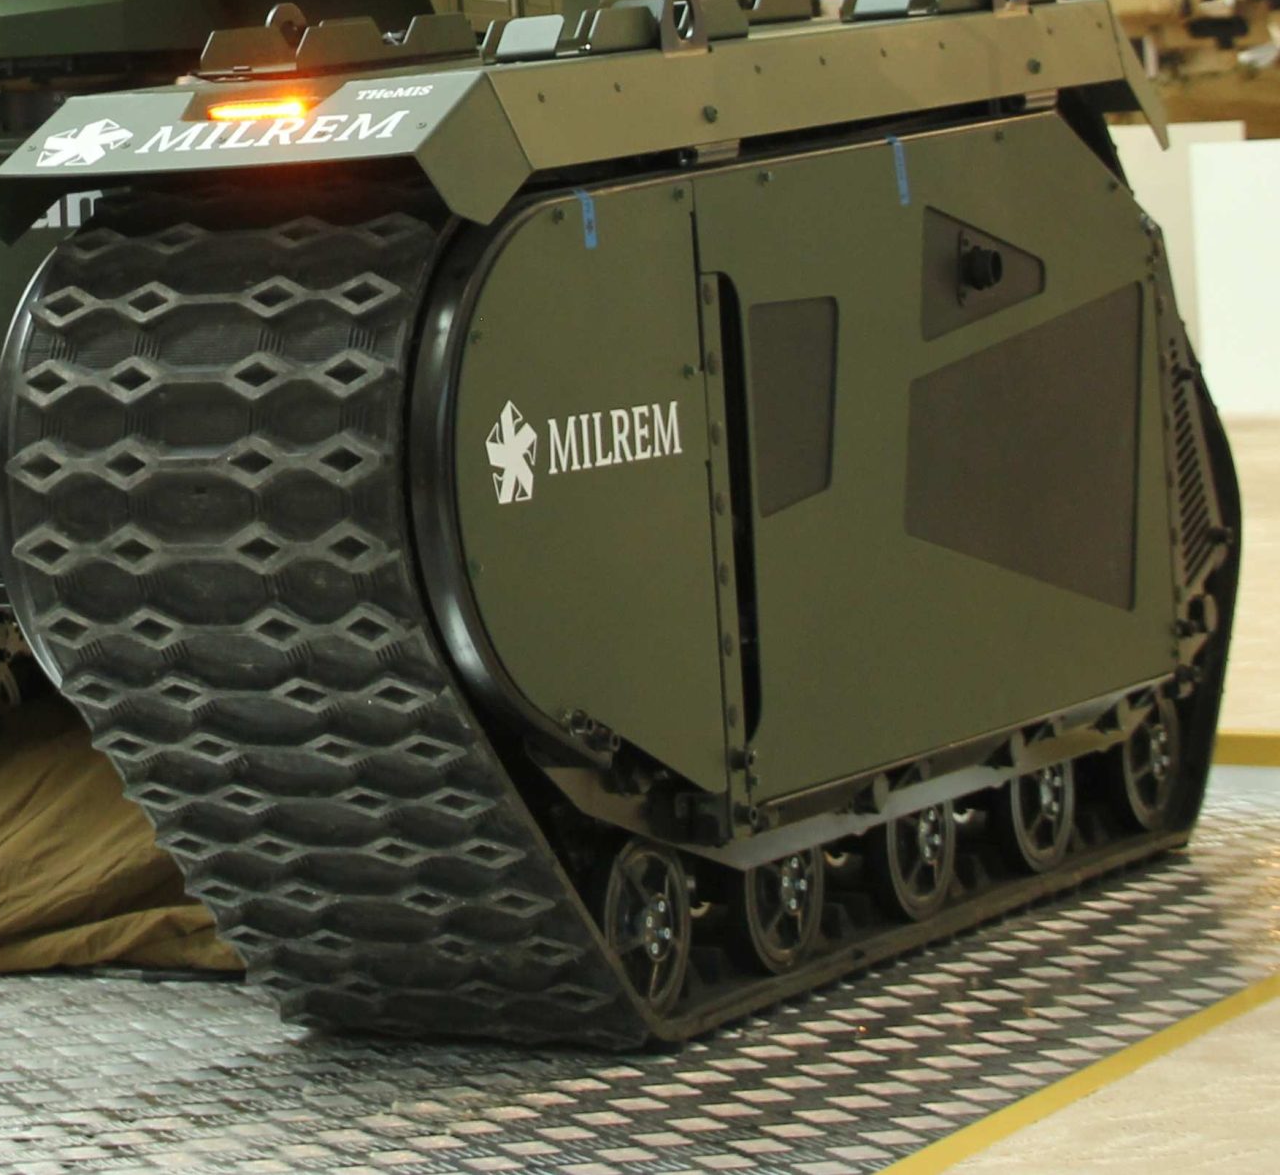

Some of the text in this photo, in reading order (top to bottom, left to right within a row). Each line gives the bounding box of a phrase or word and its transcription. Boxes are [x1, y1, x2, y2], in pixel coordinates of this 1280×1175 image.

[355, 83, 435, 102] THeMIS
[133, 110, 410, 155] MILREM
[547, 400, 684, 475] MILREM
